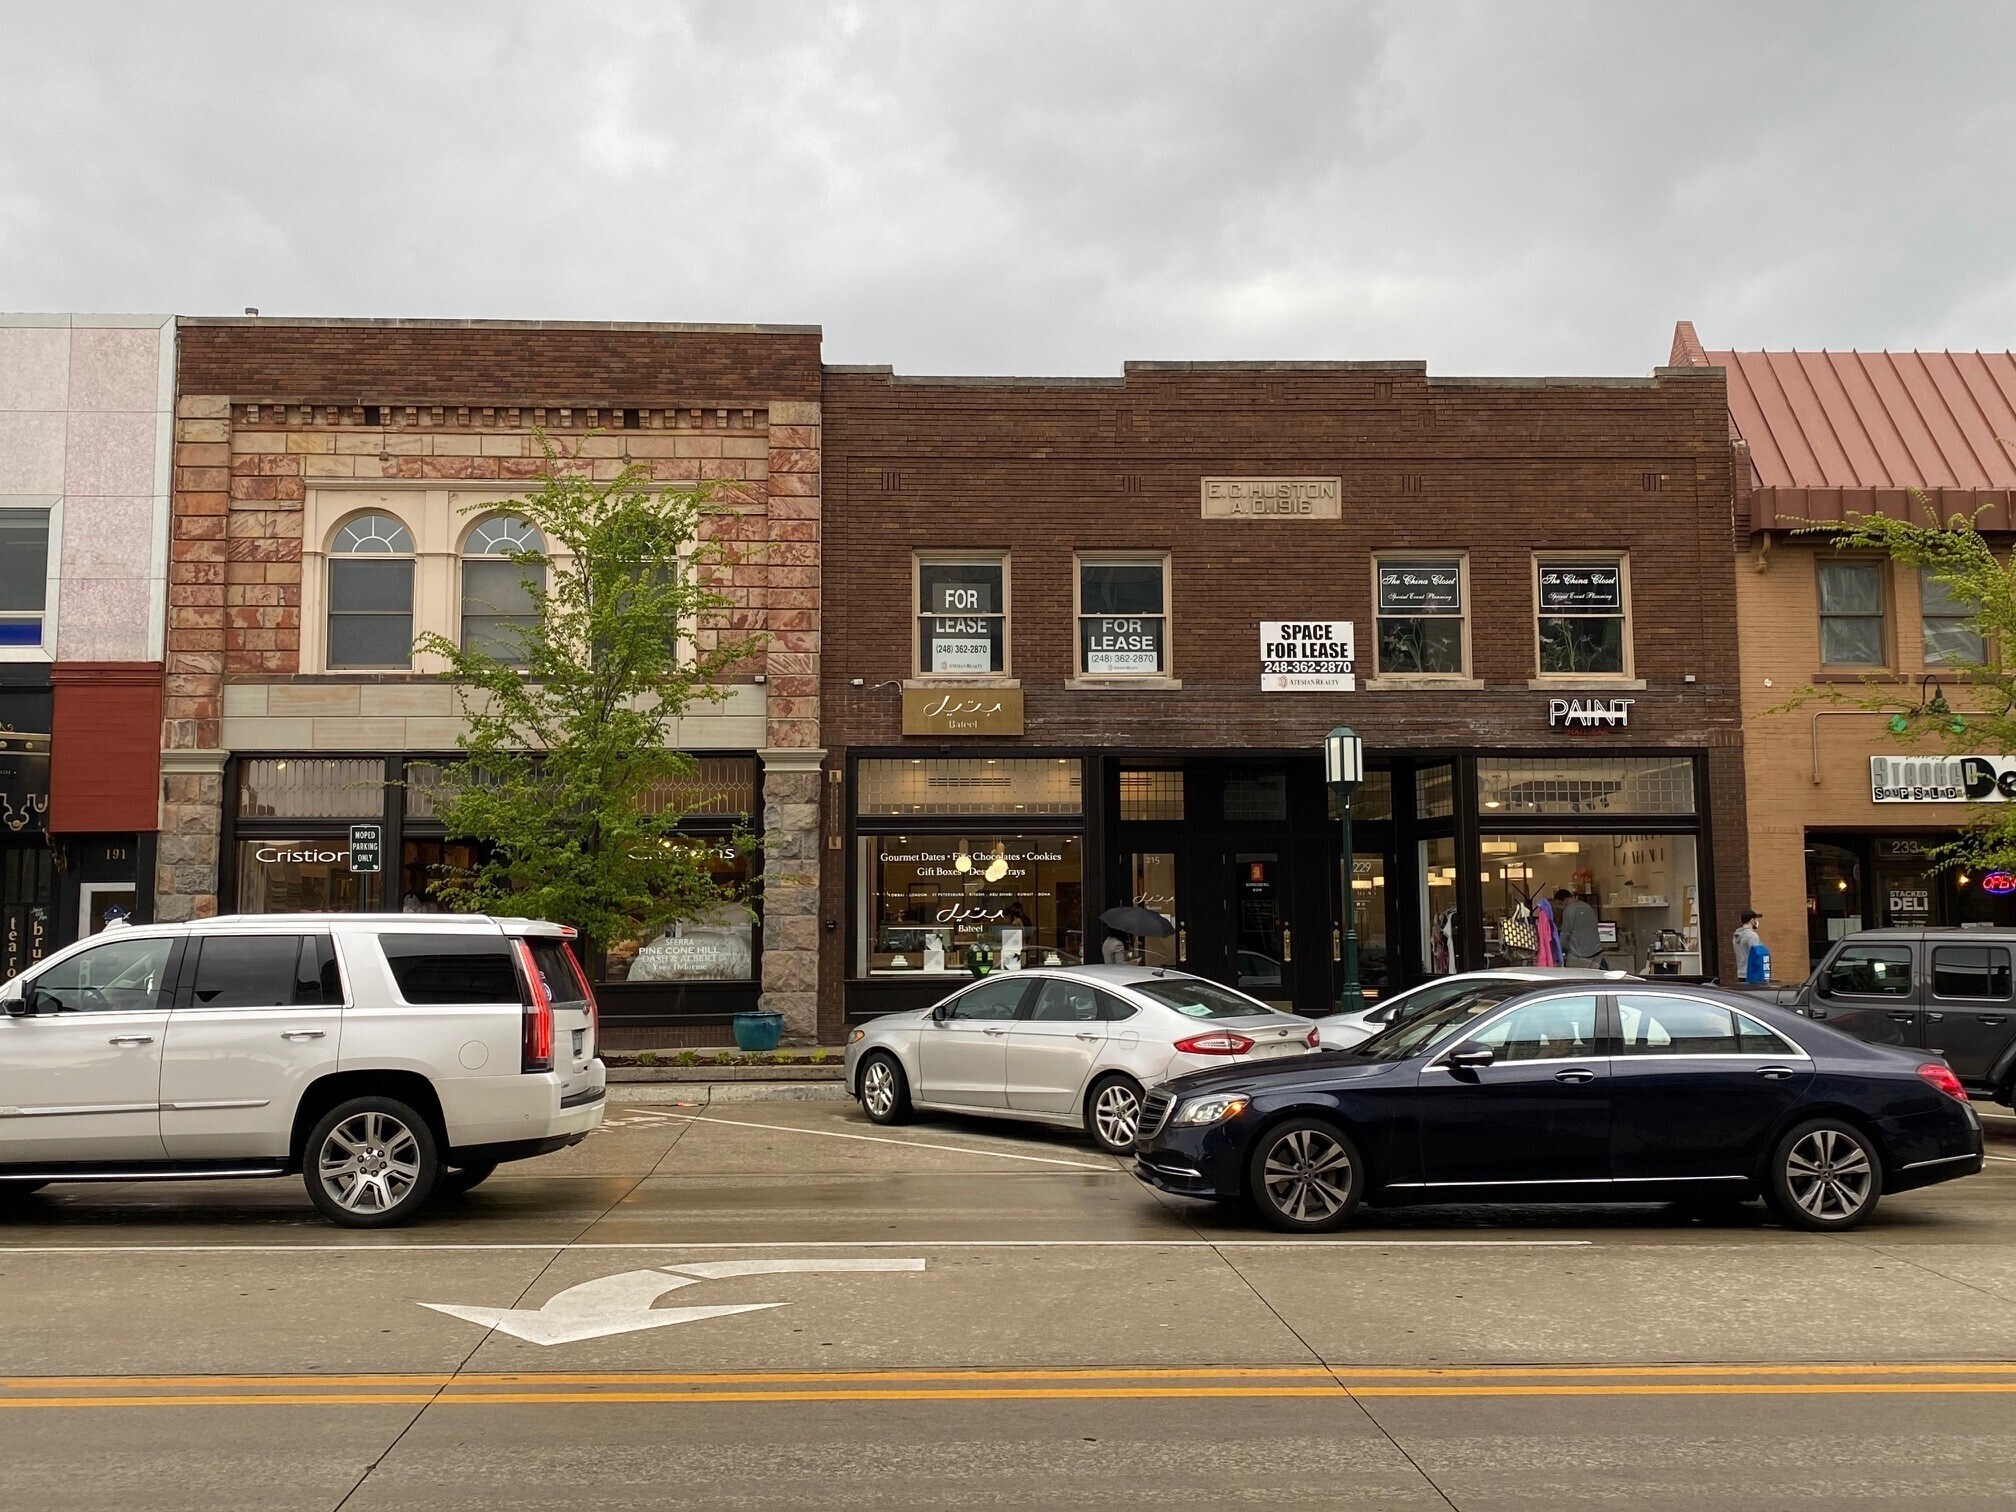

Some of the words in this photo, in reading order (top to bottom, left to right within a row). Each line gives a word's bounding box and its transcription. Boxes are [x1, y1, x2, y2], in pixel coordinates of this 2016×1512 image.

[1381, 574, 1400, 585] The
[1402, 574, 1428, 586] China
[1431, 574, 1456, 586] Closet
[1541, 573, 1560, 584] The
[1562, 573, 1588, 585] China
[1591, 573, 1616, 585] Closet
[945, 589, 978, 609] FOR
[935, 617, 988, 634] LEASE
[1102, 618, 1142, 633] FOR
[1281, 624, 1333, 641] SPACE
[1090, 635, 1154, 650] LEASE
[936, 644, 953, 655] (248)
[955, 644, 988, 654] 362-2870
[1266, 642, 1297, 659] FOR
[1301, 642, 1348, 659] LEASE
[1091, 654, 1112, 663] (248)
[1114, 654, 1154, 663] 362-2870
[1264, 661, 1351, 673] 248-362-2870
[1289, 678, 1315, 686] ATESIAN
[1315, 678, 1339, 686] REALTY
[1549, 698, 1636, 726] PAINT
[949, 720, 978, 729] Bateel
[1872, 757, 1979, 787] STACKED
[354, 831, 376, 839] MOPED
[352, 842, 379, 851] PARKING
[1892, 841, 1919, 854] 233
[105, 848, 127, 860] 191
[357, 854, 373, 862] ONLY
[880, 852, 919, 861] Gourmet
[921, 852, 946, 861] Dates
[972, 852, 1020, 861] Chocolates
[1026, 852, 1062, 861] Cookies
[1146, 856, 1160, 865] 215
[917, 867, 934, 876] Gift
[936, 867, 962, 876] Boxes
[1002, 867, 1026, 878] rays
[1352, 861, 1372, 873] 229
[1889, 890, 1928, 898] STACKED
[1890, 898, 1928, 911] DELI
[665, 938, 694, 946] SFERRA
[639, 947, 663, 955] PINE
[665, 947, 694, 955] CONE
[642, 954, 667, 963] DASH
[680, 954, 718, 962] ALBERT
